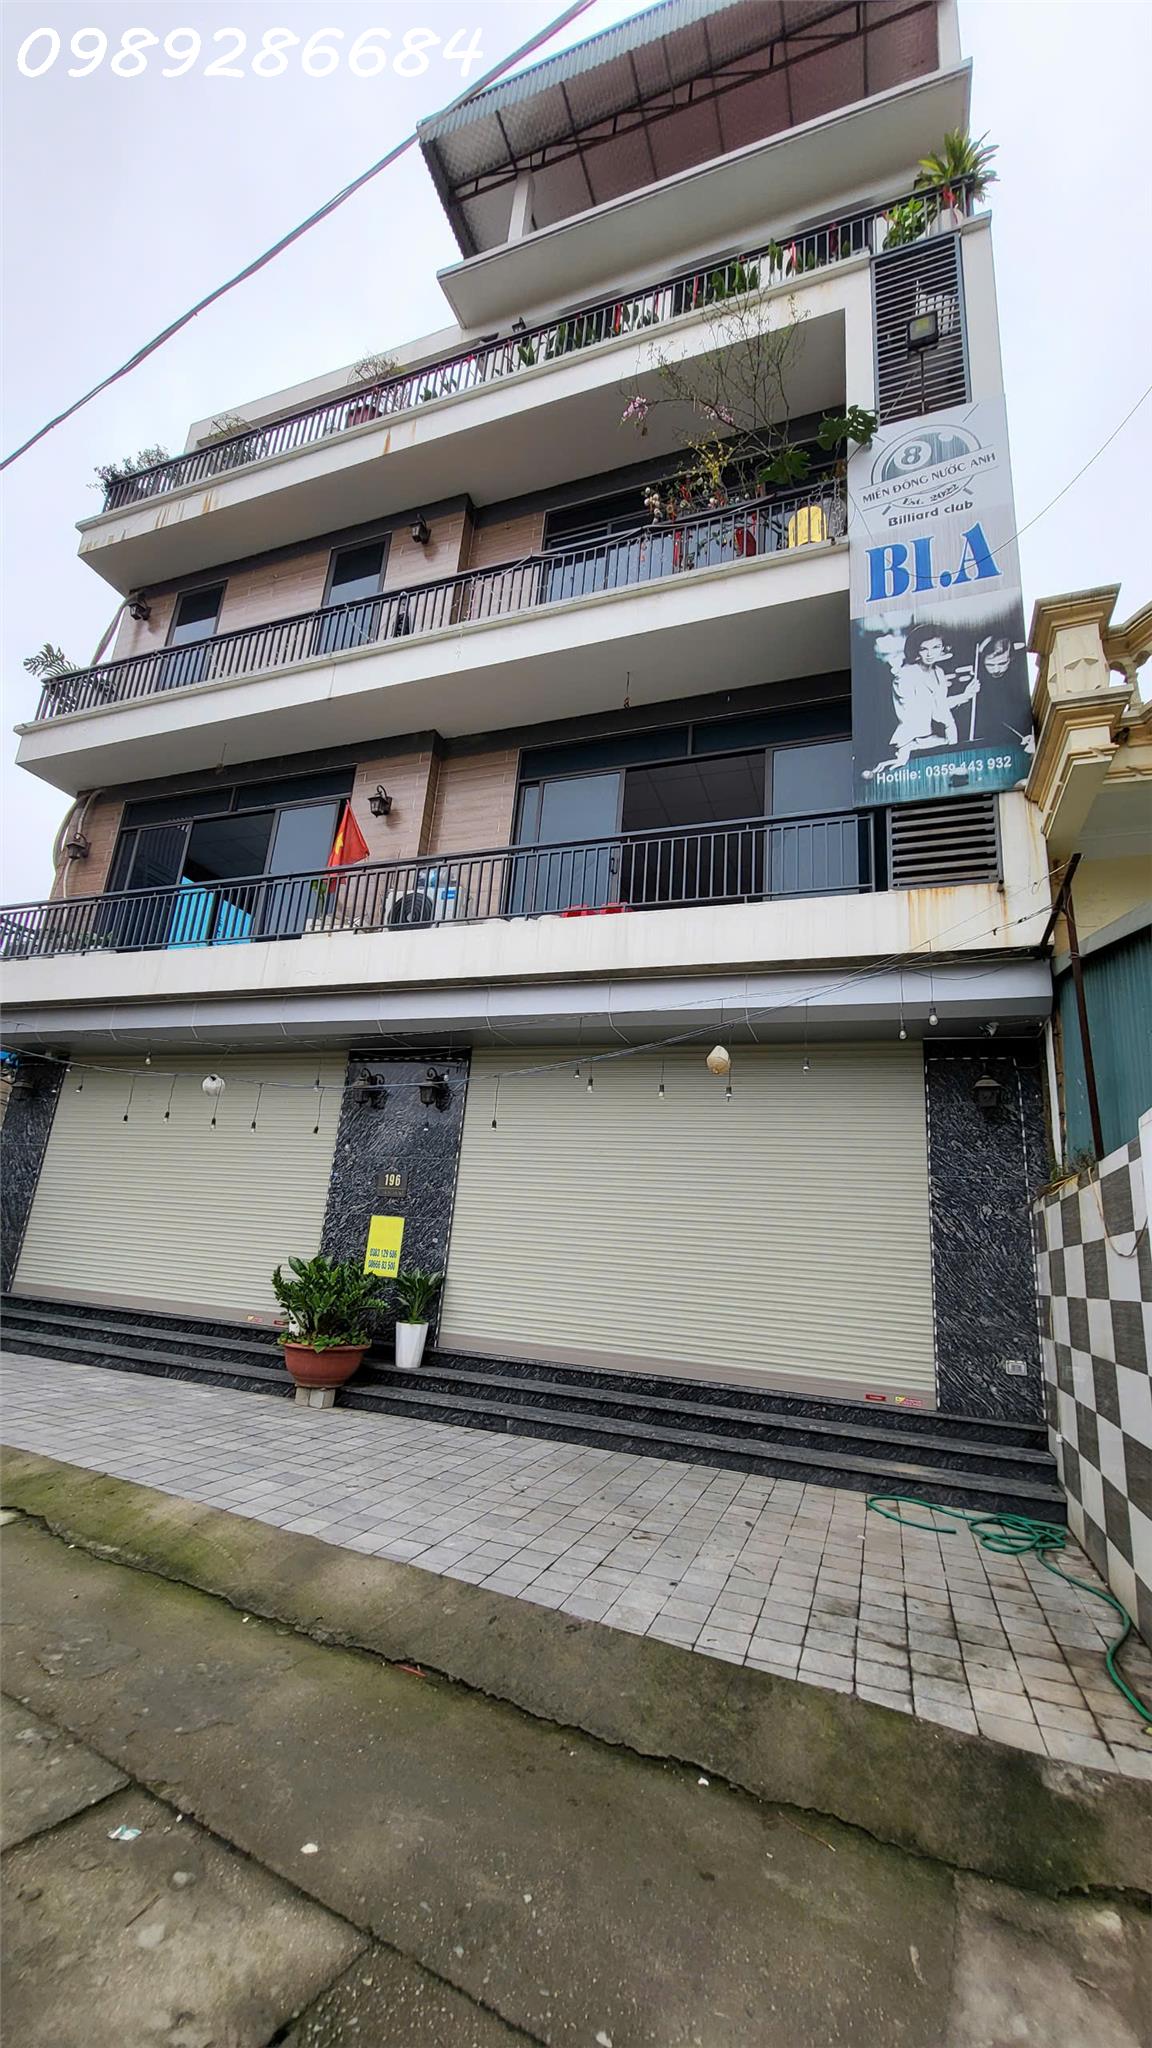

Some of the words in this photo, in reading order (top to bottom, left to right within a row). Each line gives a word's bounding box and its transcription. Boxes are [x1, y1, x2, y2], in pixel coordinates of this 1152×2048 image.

[901, 445, 922, 466] 8
[931, 463, 967, 480] NƯỚC
[970, 452, 996, 468] ANH
[888, 507, 939, 527] Billiard
[944, 500, 974, 514] club
[865, 521, 1002, 603] BI.A
[925, 763, 956, 777] 0359
[987, 755, 1012, 770] 932
[384, 1173, 402, 1186] 196
